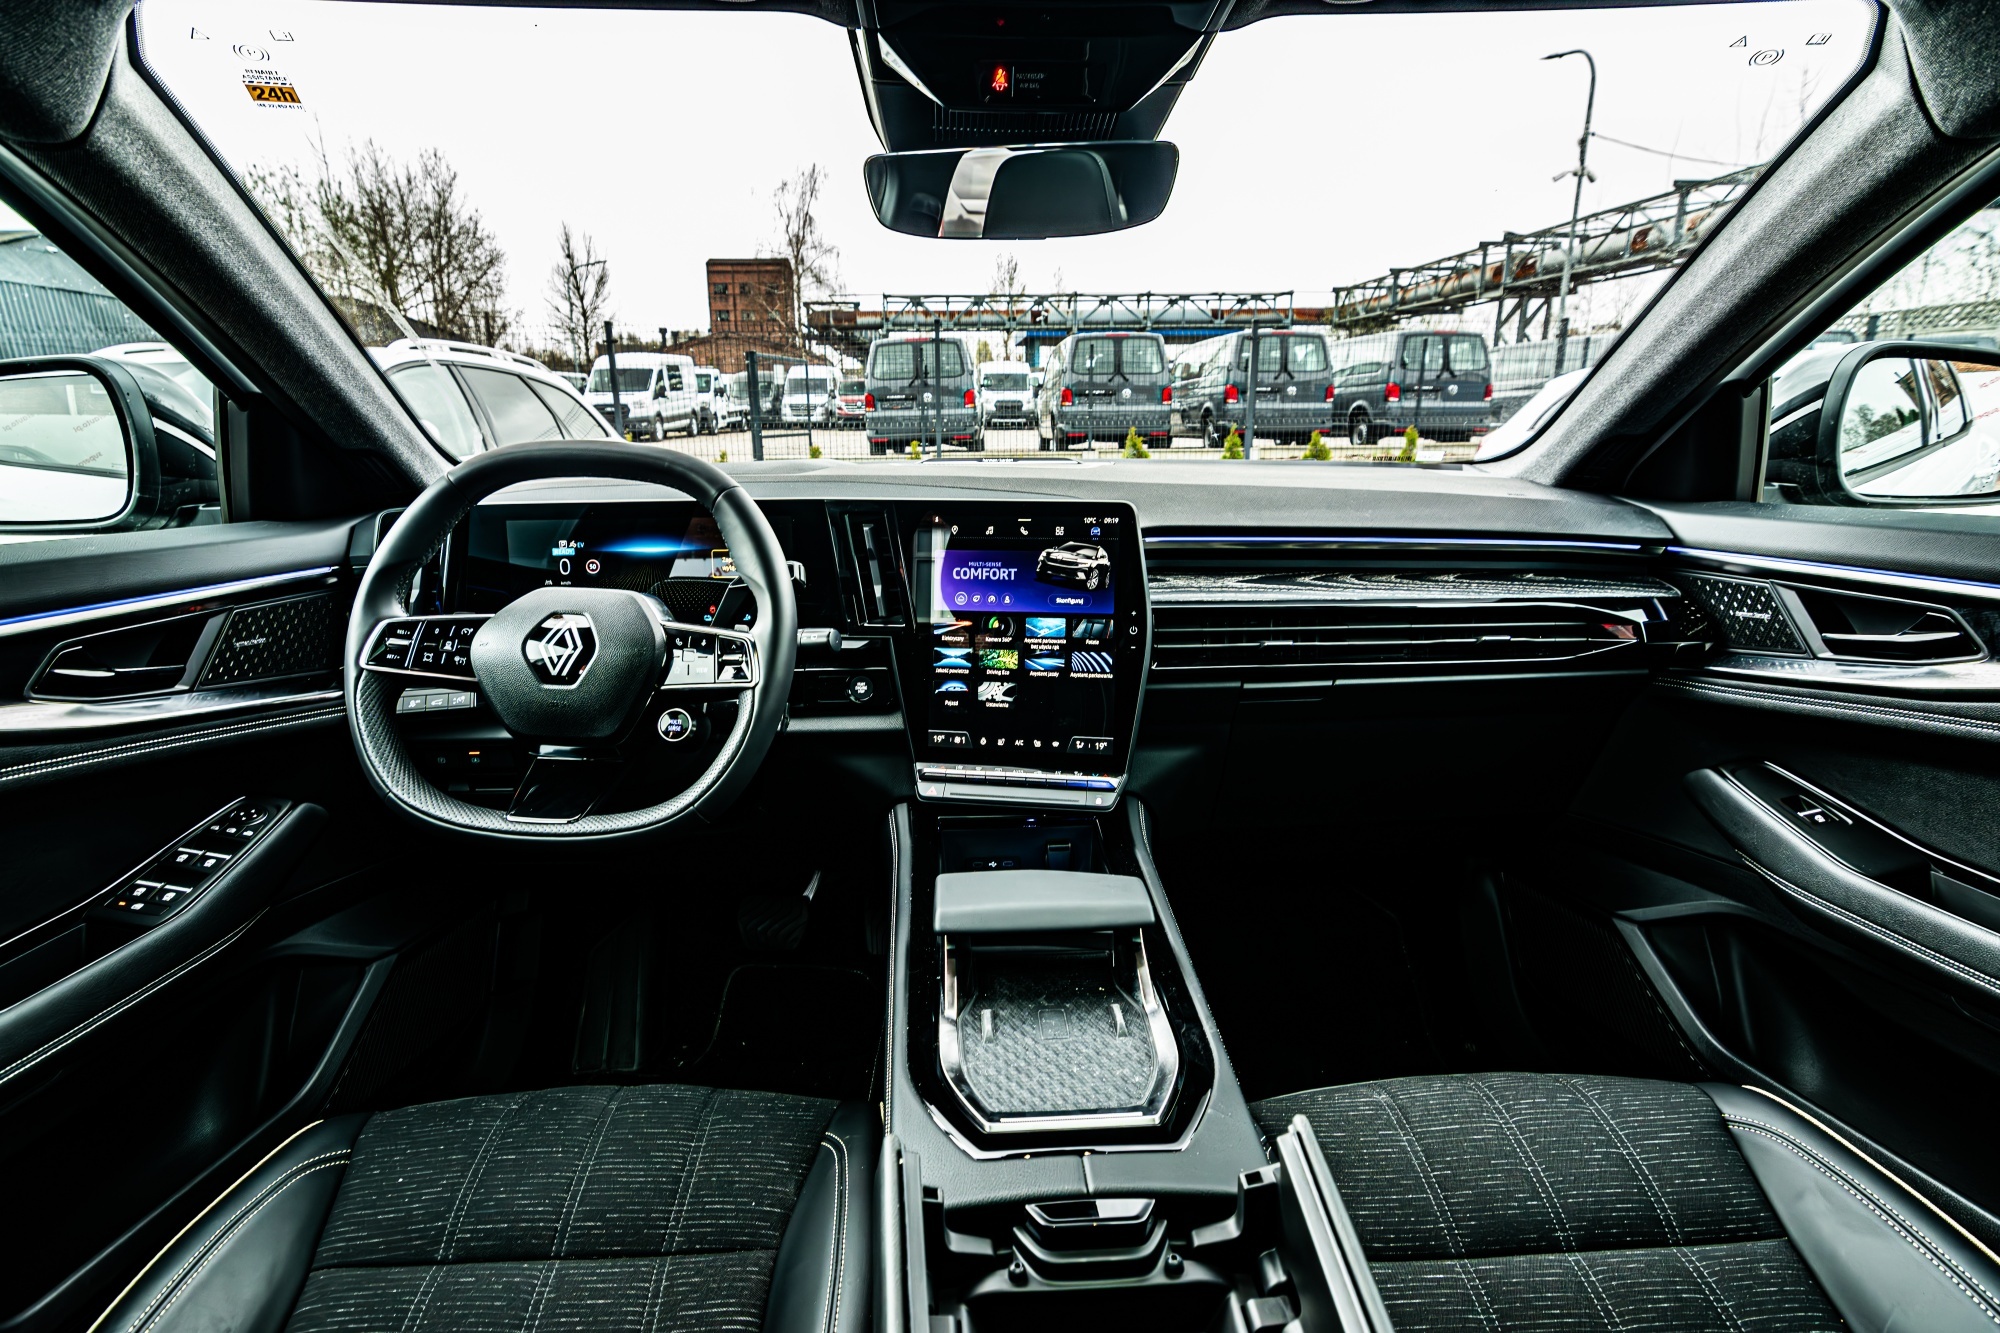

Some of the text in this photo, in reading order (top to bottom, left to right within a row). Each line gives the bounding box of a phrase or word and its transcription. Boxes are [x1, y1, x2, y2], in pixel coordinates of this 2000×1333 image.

[252, 86, 297, 102] 24h
[577, 541, 585, 549] EV
[560, 558, 571, 575] 0
[952, 567, 1018, 580] COMFORT
